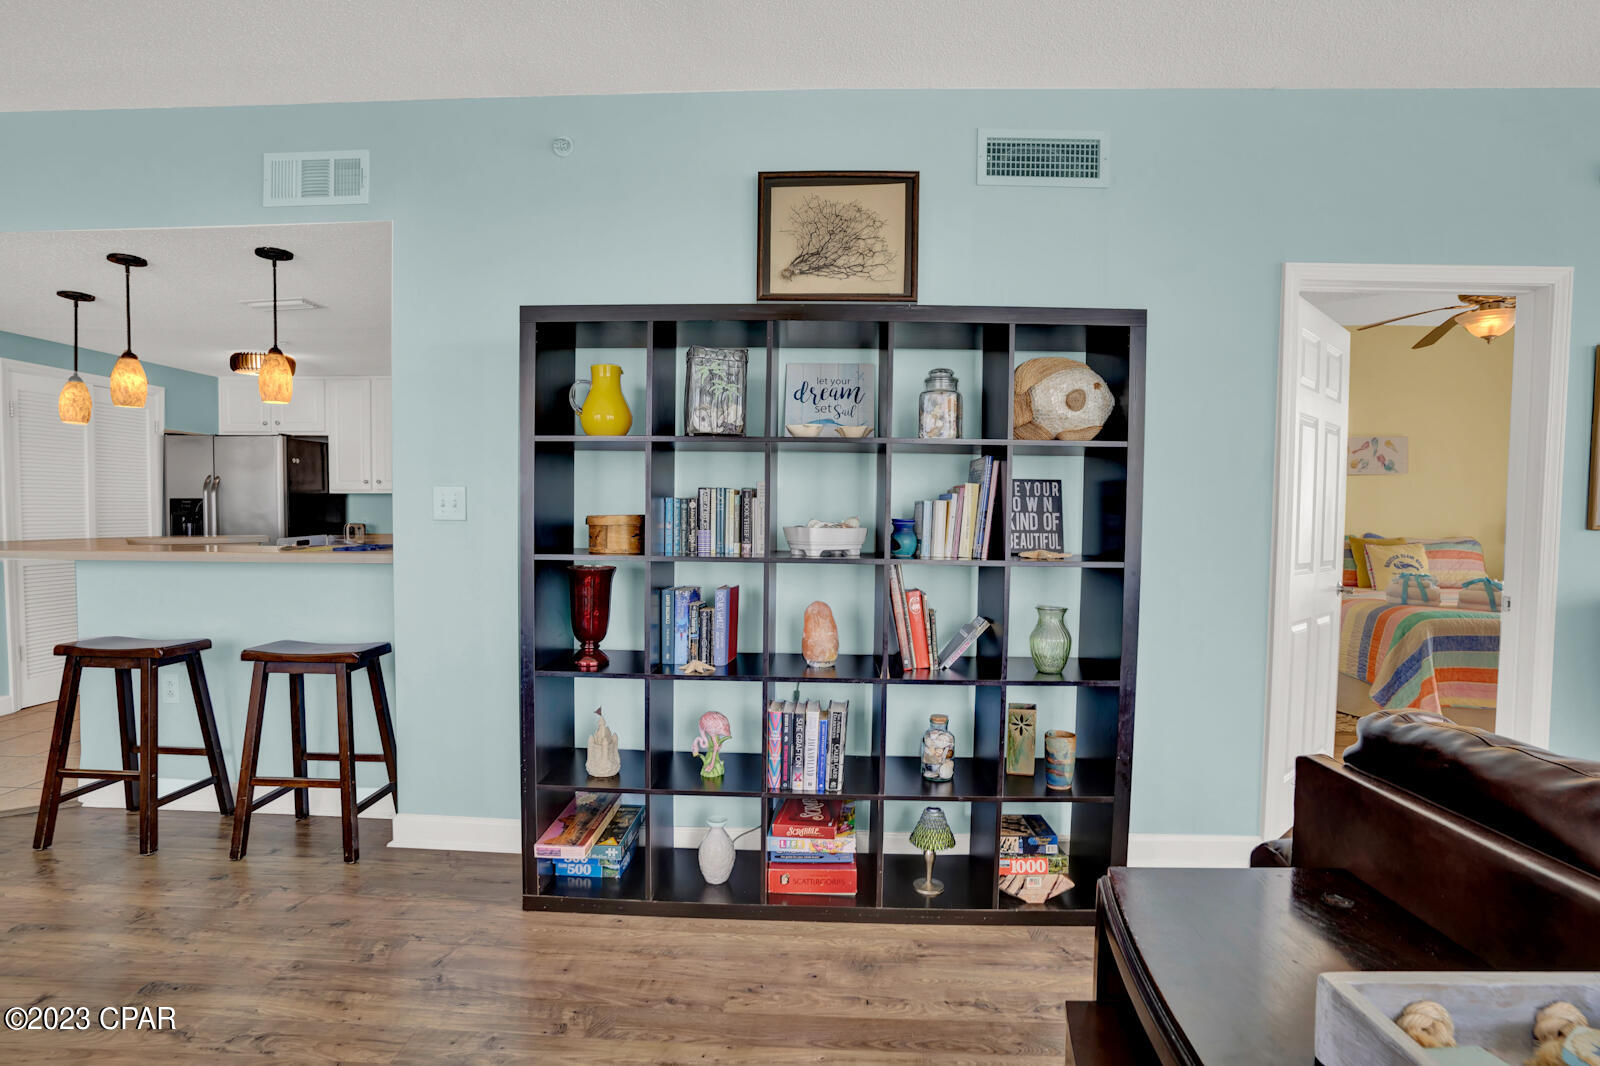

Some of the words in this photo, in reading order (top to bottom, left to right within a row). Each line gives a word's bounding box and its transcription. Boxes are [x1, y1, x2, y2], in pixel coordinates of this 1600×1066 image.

[816, 377, 828, 385] let
[830, 378, 851, 387] your
[793, 380, 866, 405] dream
[814, 404, 832, 413] set
[833, 404, 857, 420] Sail
[1024, 482, 1060, 496] YOUR
[1012, 497, 1053, 512] OWN
[1043, 513, 1060, 531] OF
[795, 733, 803, 768] GRAFTON
[567, 863, 592, 875] 500
[1011, 859, 1047, 873] 1000
